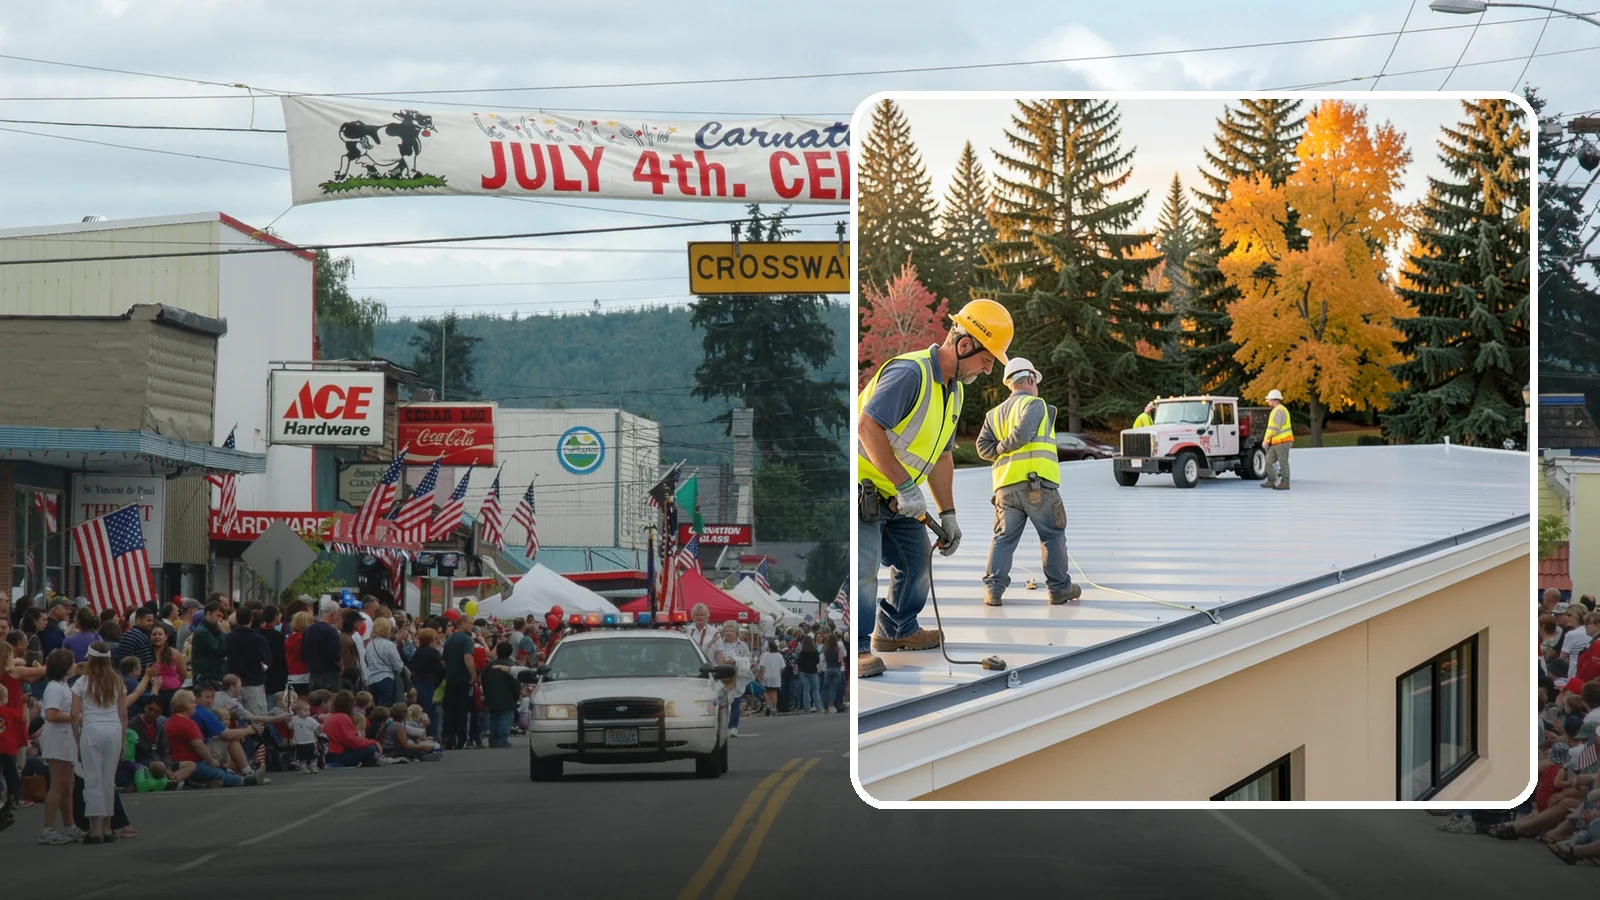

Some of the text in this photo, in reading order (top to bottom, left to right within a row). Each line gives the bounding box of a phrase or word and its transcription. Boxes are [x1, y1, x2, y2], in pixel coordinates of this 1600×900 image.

[481, 140, 605, 193] JULY
[632, 150, 747, 197] 4th.
[697, 254, 850, 280] CROSSWA
[282, 380, 374, 420] ACE
[405, 409, 485, 422] CEDAR LOG
[283, 421, 371, 437] Hardware
[416, 428, 477, 447] Coca-Cola
[96, 485, 124, 495] Vincent
[126, 486, 136, 495] de
[137, 486, 155, 495] Paul
[81, 503, 154, 522] THT
[688, 526, 741, 535] CRNATION
[699, 535, 730, 543] GLASS
